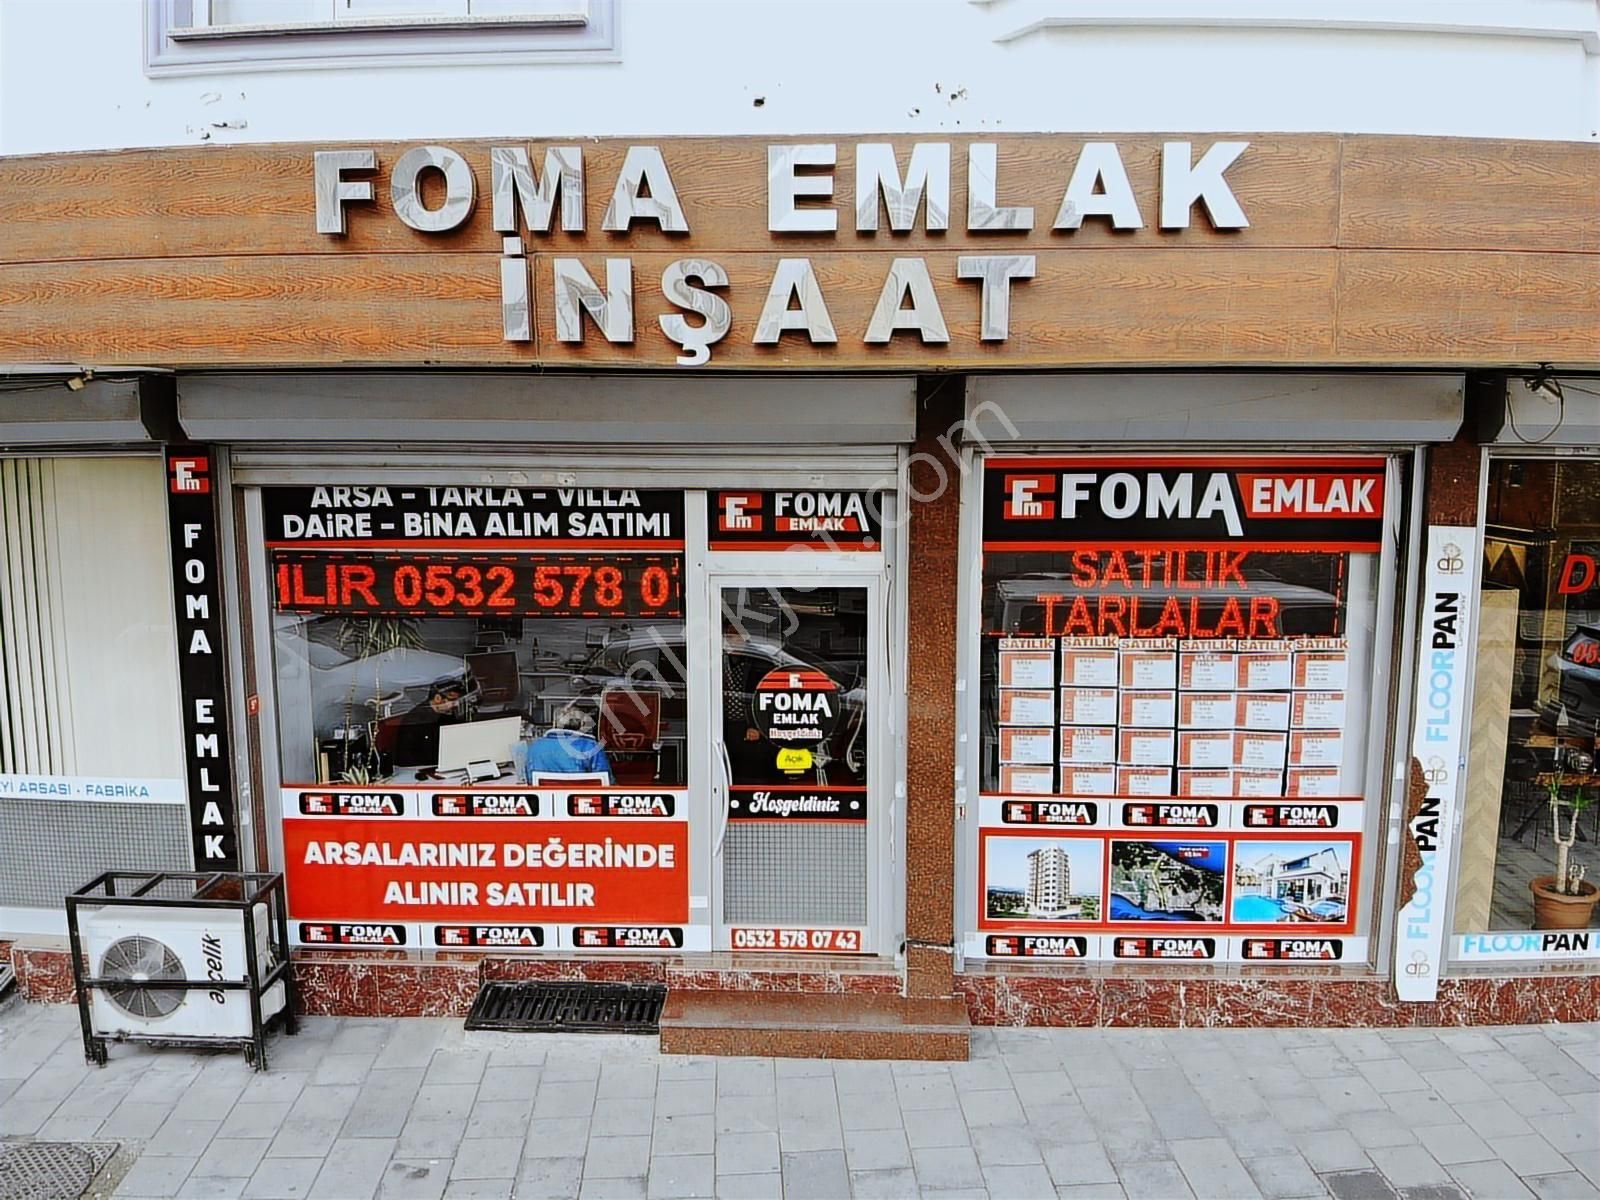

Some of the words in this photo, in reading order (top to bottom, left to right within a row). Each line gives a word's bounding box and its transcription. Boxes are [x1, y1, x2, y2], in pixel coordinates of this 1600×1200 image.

[314, 145, 690, 235] FOMA
[768, 141, 1251, 232] EMLAK
[500, 236, 1037, 366] İNŞAAT
[310, 487, 394, 508] ARSA
[425, 487, 524, 507] TARLA
[557, 488, 641, 507] VILLA
[1061, 473, 1244, 536] FOMA
[1252, 478, 1376, 513] EMLAK
[775, 492, 870, 532] FOMA
[484, 512, 559, 537] ALIM
[568, 512, 670, 537] SATIMI
[789, 517, 845, 531] EMLAK
[1071, 550, 1248, 590] SATILIK
[1558, 554, 1600, 594] D
[184, 523, 213, 654] FOMA
[394, 565, 516, 607] 0532
[533, 566, 623, 607] 578
[1037, 594, 1281, 637] TARLALAR
[1000, 639, 1054, 649] SATILIK
[1063, 636, 1116, 647] SATILIK
[1120, 638, 1175, 650] SATILIK
[1182, 640, 1236, 650] SATILIK
[1240, 641, 1293, 651] SATILIK
[1296, 639, 1348, 649] SATILIK
[1573, 641, 1600, 664] 05
[759, 692, 833, 718] FOMA
[773, 713, 819, 725] EMLAK
[195, 699, 226, 858] EMLAK
[0, 780, 14, 793] Yİ
[19, 781, 72, 796] ARSASI
[86, 782, 149, 798] FABRİKA
[339, 795, 398, 814] FOMA
[473, 796, 532, 815] FOMA
[608, 796, 668, 815] FOMA
[1038, 803, 1091, 823] FOMA
[1159, 805, 1212, 825] FOMA
[1280, 806, 1332, 826] FOMA
[304, 840, 497, 867] ARSALARINIZ
[504, 837, 675, 869] DEĞERİNDE
[384, 880, 480, 907] ALINIR
[486, 882, 596, 908] SATILIR
[340, 925, 400, 944] FOMA
[476, 927, 537, 946] FOMA
[615, 928, 676, 947] FOMA
[735, 929, 776, 948] 0532
[779, 930, 808, 949] 578
[812, 930, 832, 949] 07
[835, 931, 857, 949] 42
[1463, 932, 1589, 953] FLOORPAN
[1024, 937, 1081, 956] FOMA
[1152, 939, 1209, 958] FOMA
[1280, 940, 1336, 958] FOMA
